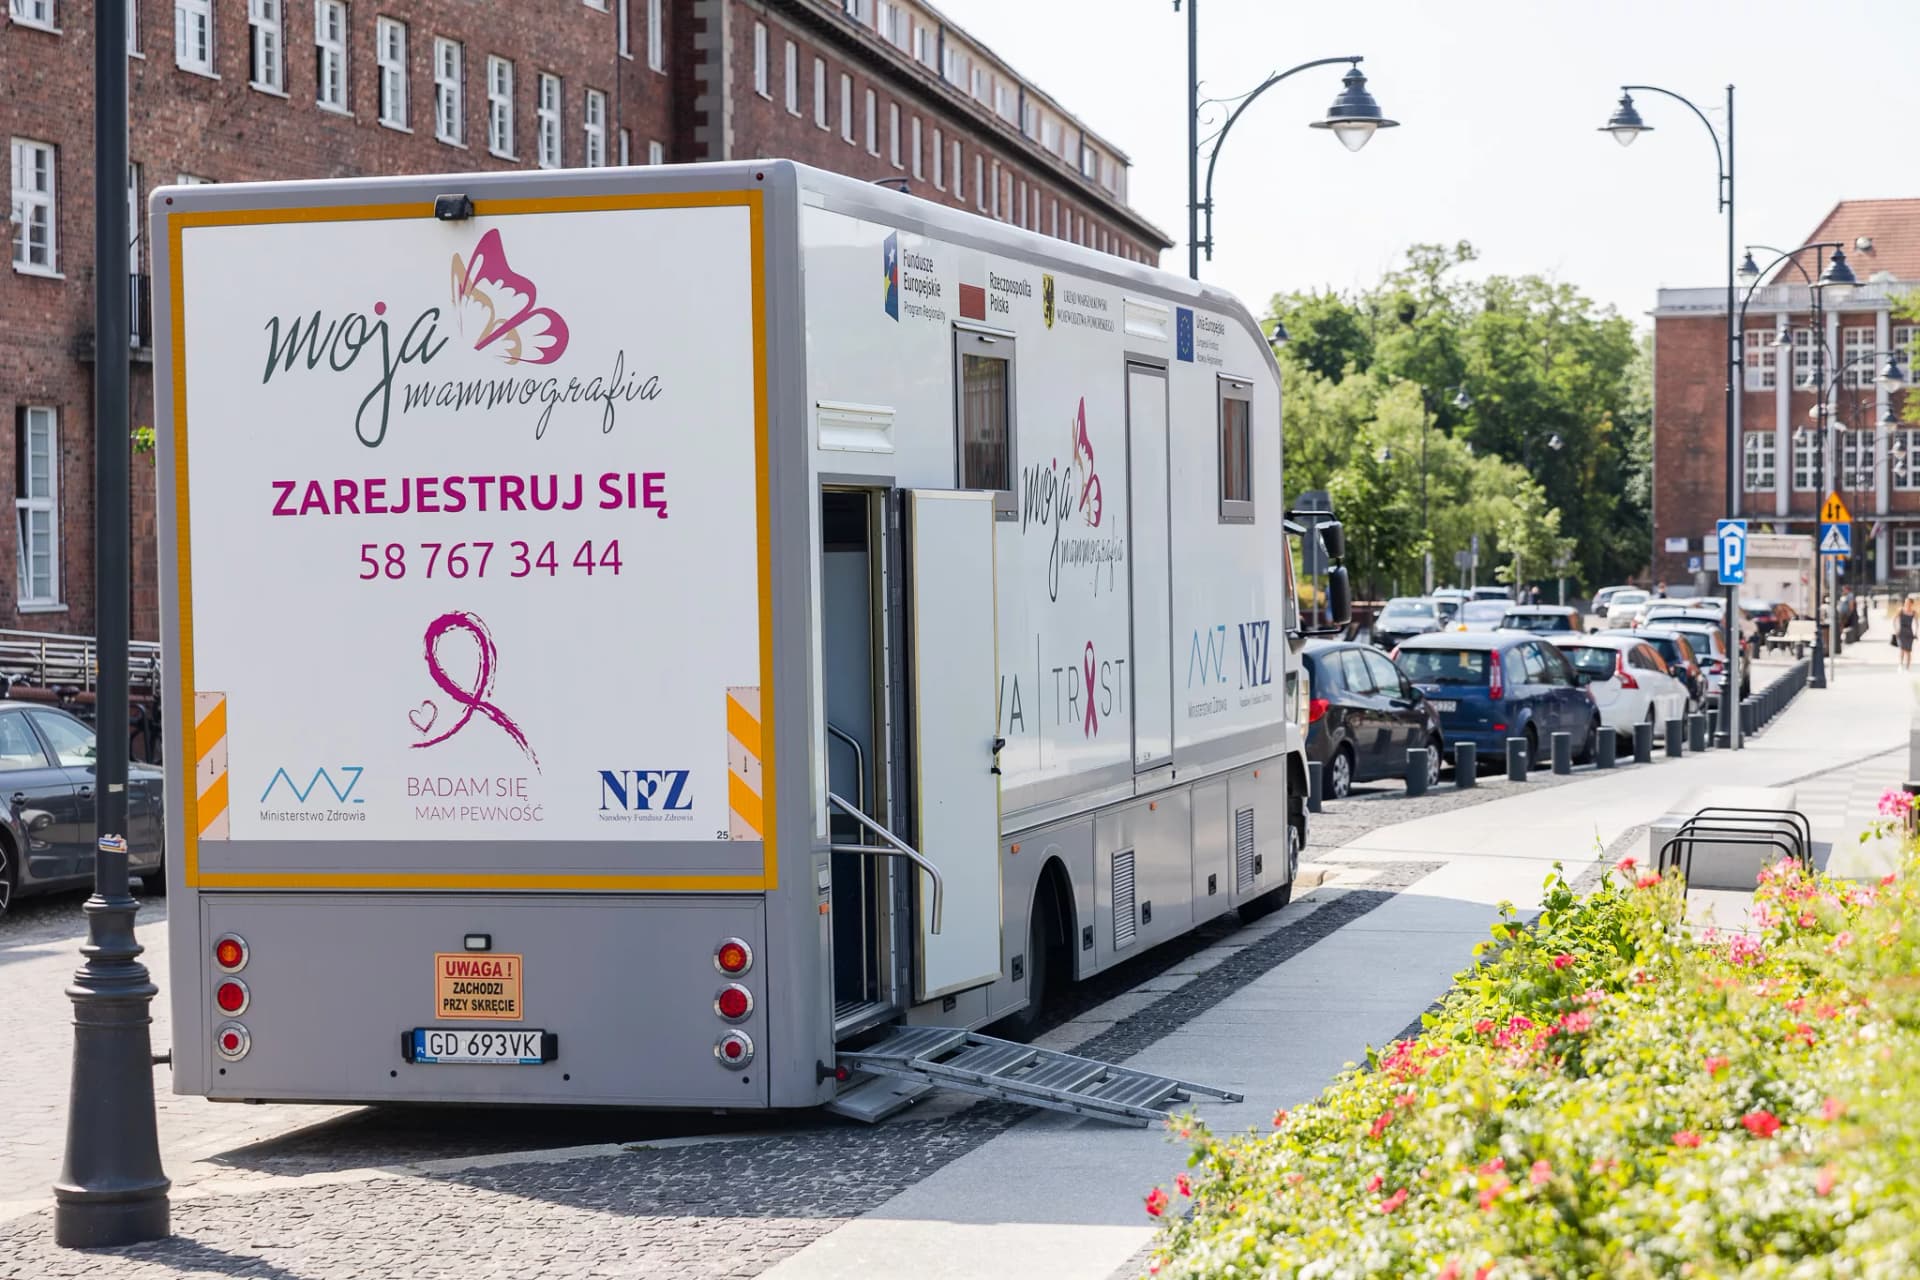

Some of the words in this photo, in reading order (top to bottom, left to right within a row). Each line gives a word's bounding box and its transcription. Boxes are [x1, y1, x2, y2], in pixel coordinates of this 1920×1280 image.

[903, 249, 934, 273] Fundusze
[903, 271, 941, 299] Europejskie
[989, 271, 1032, 298] Rzeczpospolita
[990, 293, 1009, 314] Polska
[263, 301, 449, 448] moja
[403, 350, 662, 441] mammografia
[272, 474, 583, 516] ZAREJESTRUJ
[599, 472, 669, 519] SIĘ
[1023, 457, 1073, 602] moja
[359, 543, 407, 580] 58
[421, 542, 495, 578] 767
[510, 541, 559, 577] 34
[573, 539, 623, 576] 44
[1724, 536, 1741, 576] P
[1238, 620, 1271, 690] NFZ
[407, 777, 489, 797] BADAM
[495, 777, 528, 801] SIĘ
[598, 769, 693, 811] NFZ
[260, 810, 324, 821] Ministerstwo
[327, 809, 366, 821] Zdrowia
[415, 806, 456, 821] MAM
[460, 804, 544, 822] PEWNOŚĆ
[599, 813, 632, 823] Narodowy
[634, 813, 663, 822] Fundusz
[664, 813, 694, 822] Zdrowia
[716, 831, 729, 840] 25
[446, 961, 502, 976] UWAGA
[453, 982, 503, 995] ZACHODZI
[443, 999, 468, 1010] PRZY
[472, 1000, 515, 1014] SKRĘCIE
[430, 1034, 458, 1055] GD
[468, 1034, 536, 1057] 693VK
